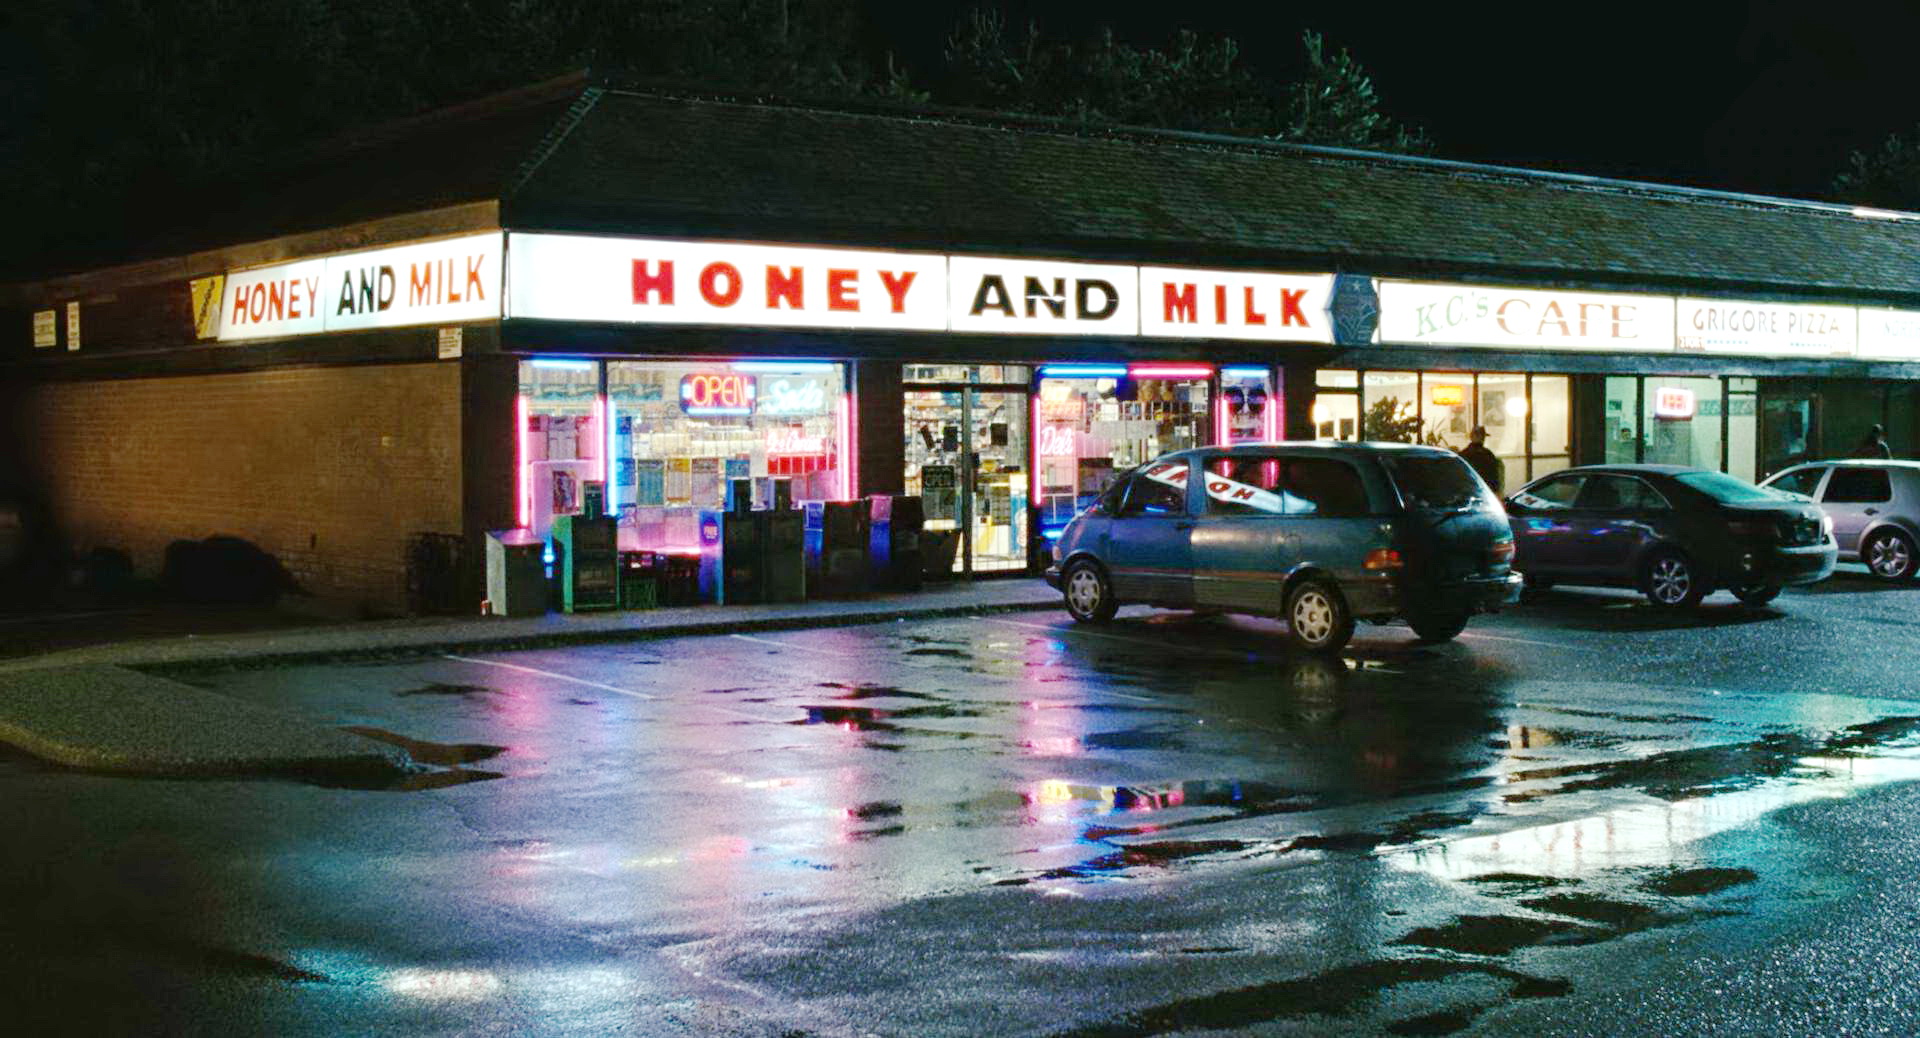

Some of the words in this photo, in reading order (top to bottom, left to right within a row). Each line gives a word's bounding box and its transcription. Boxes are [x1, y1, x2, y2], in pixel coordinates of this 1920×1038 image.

[232, 276, 319, 325] HONEY
[336, 265, 396, 316] AND
[409, 254, 485, 307] MILK
[632, 258, 918, 314] HONEY
[969, 274, 1120, 320] AND
[1162, 281, 1310, 327] MILK
[1496, 299, 1638, 339] CAFE
[1693, 308, 1777, 333] GRIGORE
[1789, 312, 1840, 335] PIZZA
[691, 376, 748, 407] OPEN
[1041, 426, 1073, 455] Deli
